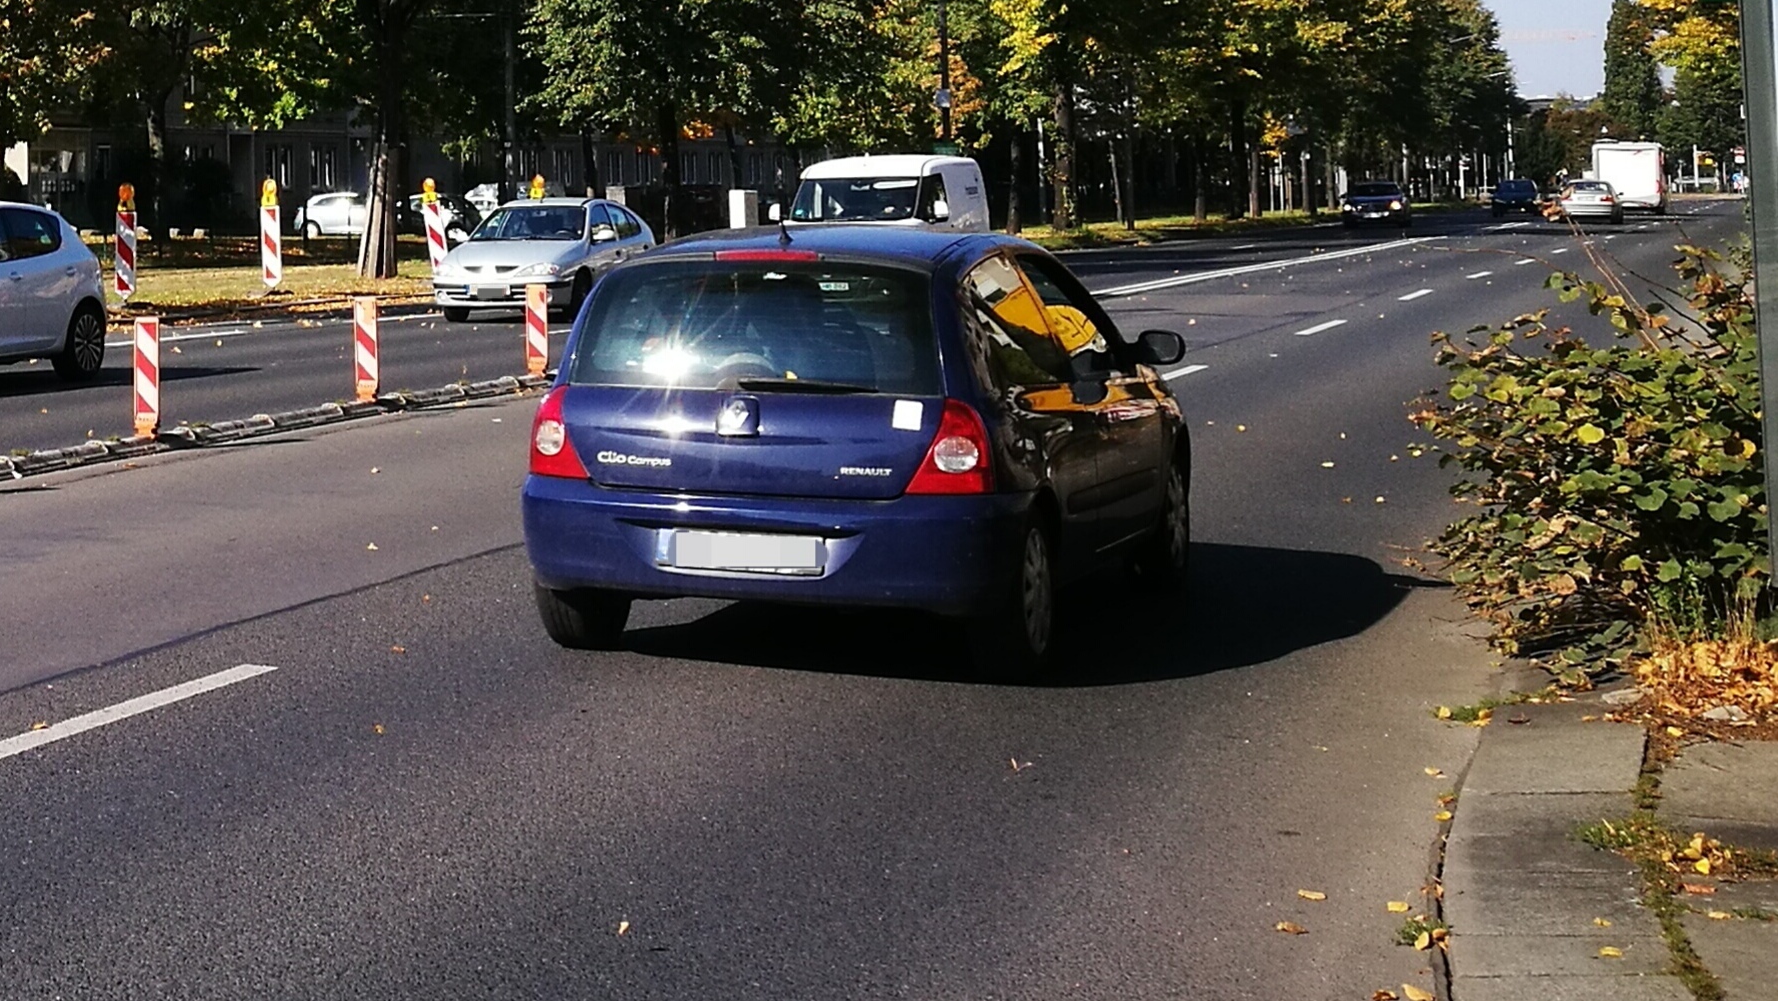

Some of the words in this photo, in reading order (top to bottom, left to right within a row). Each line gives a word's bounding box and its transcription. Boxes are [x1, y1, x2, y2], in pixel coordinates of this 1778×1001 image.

[597, 451, 627, 464] Clio
[627, 454, 672, 467] Campus
[840, 467, 893, 477] RENAULT
